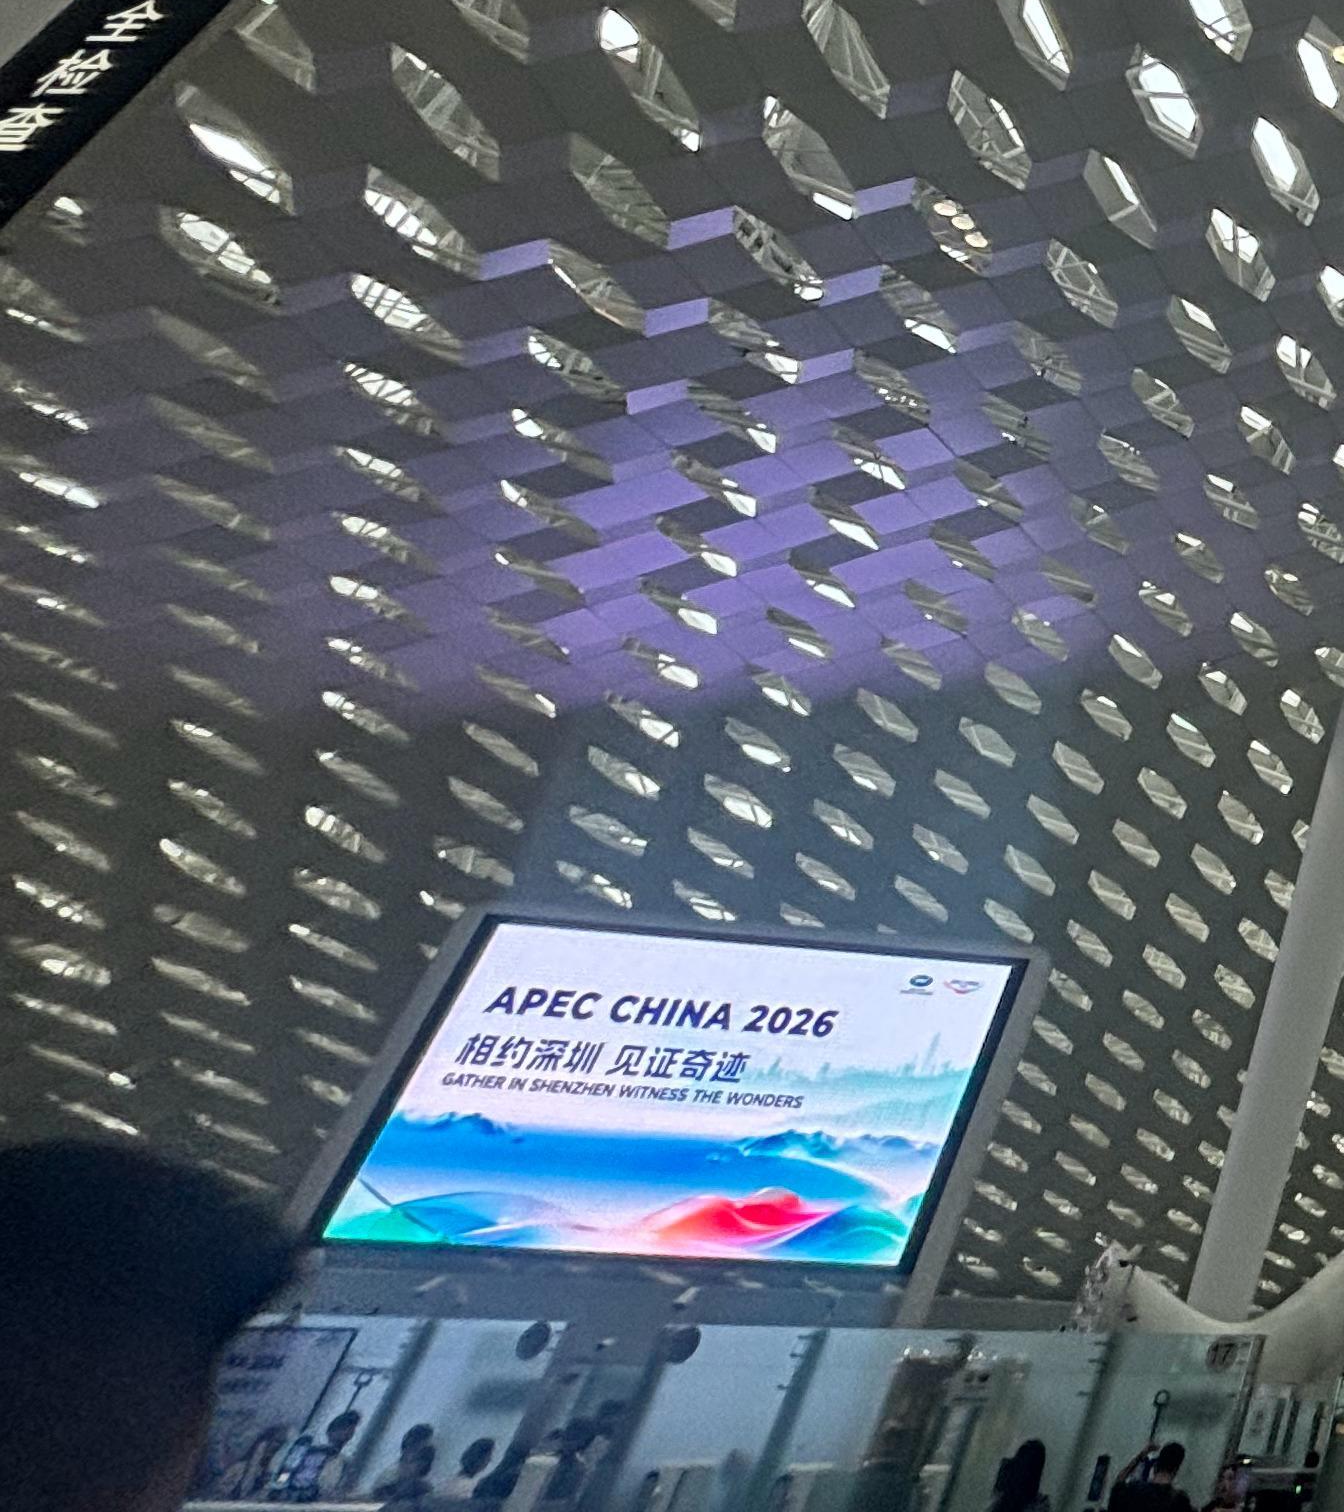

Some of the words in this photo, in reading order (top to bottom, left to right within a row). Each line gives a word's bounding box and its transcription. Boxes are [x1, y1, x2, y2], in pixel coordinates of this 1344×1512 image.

[482, 985, 602, 1021] APEC
[610, 995, 733, 1031] CHINA
[742, 1003, 840, 1038] 2026
[454, 1033, 607, 1074] 相约深圳
[607, 1044, 752, 1084] 见证奇迹
[442, 1072, 506, 1090] GATHER
[508, 1076, 526, 1092] IN
[529, 1078, 617, 1098] SHENZHEN
[620, 1084, 689, 1103] WITNESS
[692, 1088, 724, 1105] THE
[726, 1090, 805, 1109] WONDERS
[1210, 1342, 1237, 1366] 17
